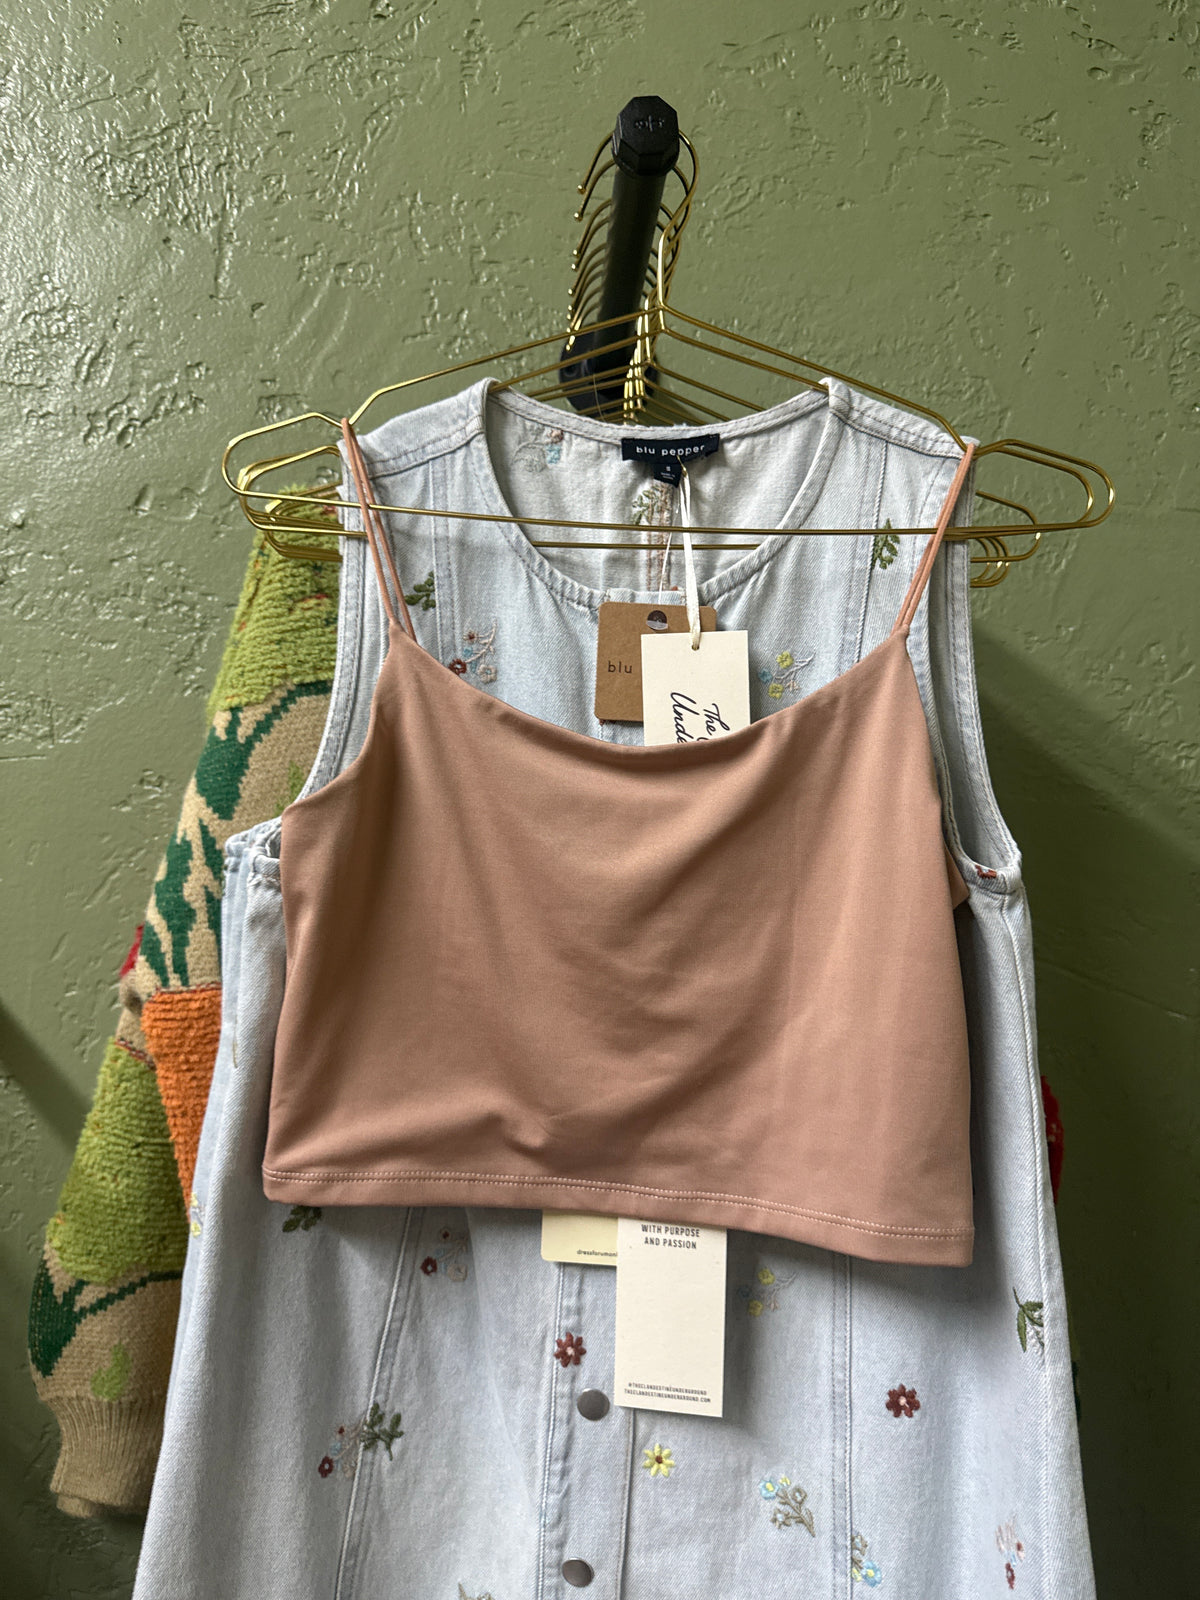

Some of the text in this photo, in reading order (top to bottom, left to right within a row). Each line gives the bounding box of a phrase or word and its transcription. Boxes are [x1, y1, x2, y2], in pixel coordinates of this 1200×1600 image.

[636, 445, 705, 456] blu pepper
[607, 661, 633, 673] blu
[703, 703, 730, 735] The
[641, 1224, 700, 1238] WITH PURPOSE
[644, 1237, 697, 1250] AND PASSION
